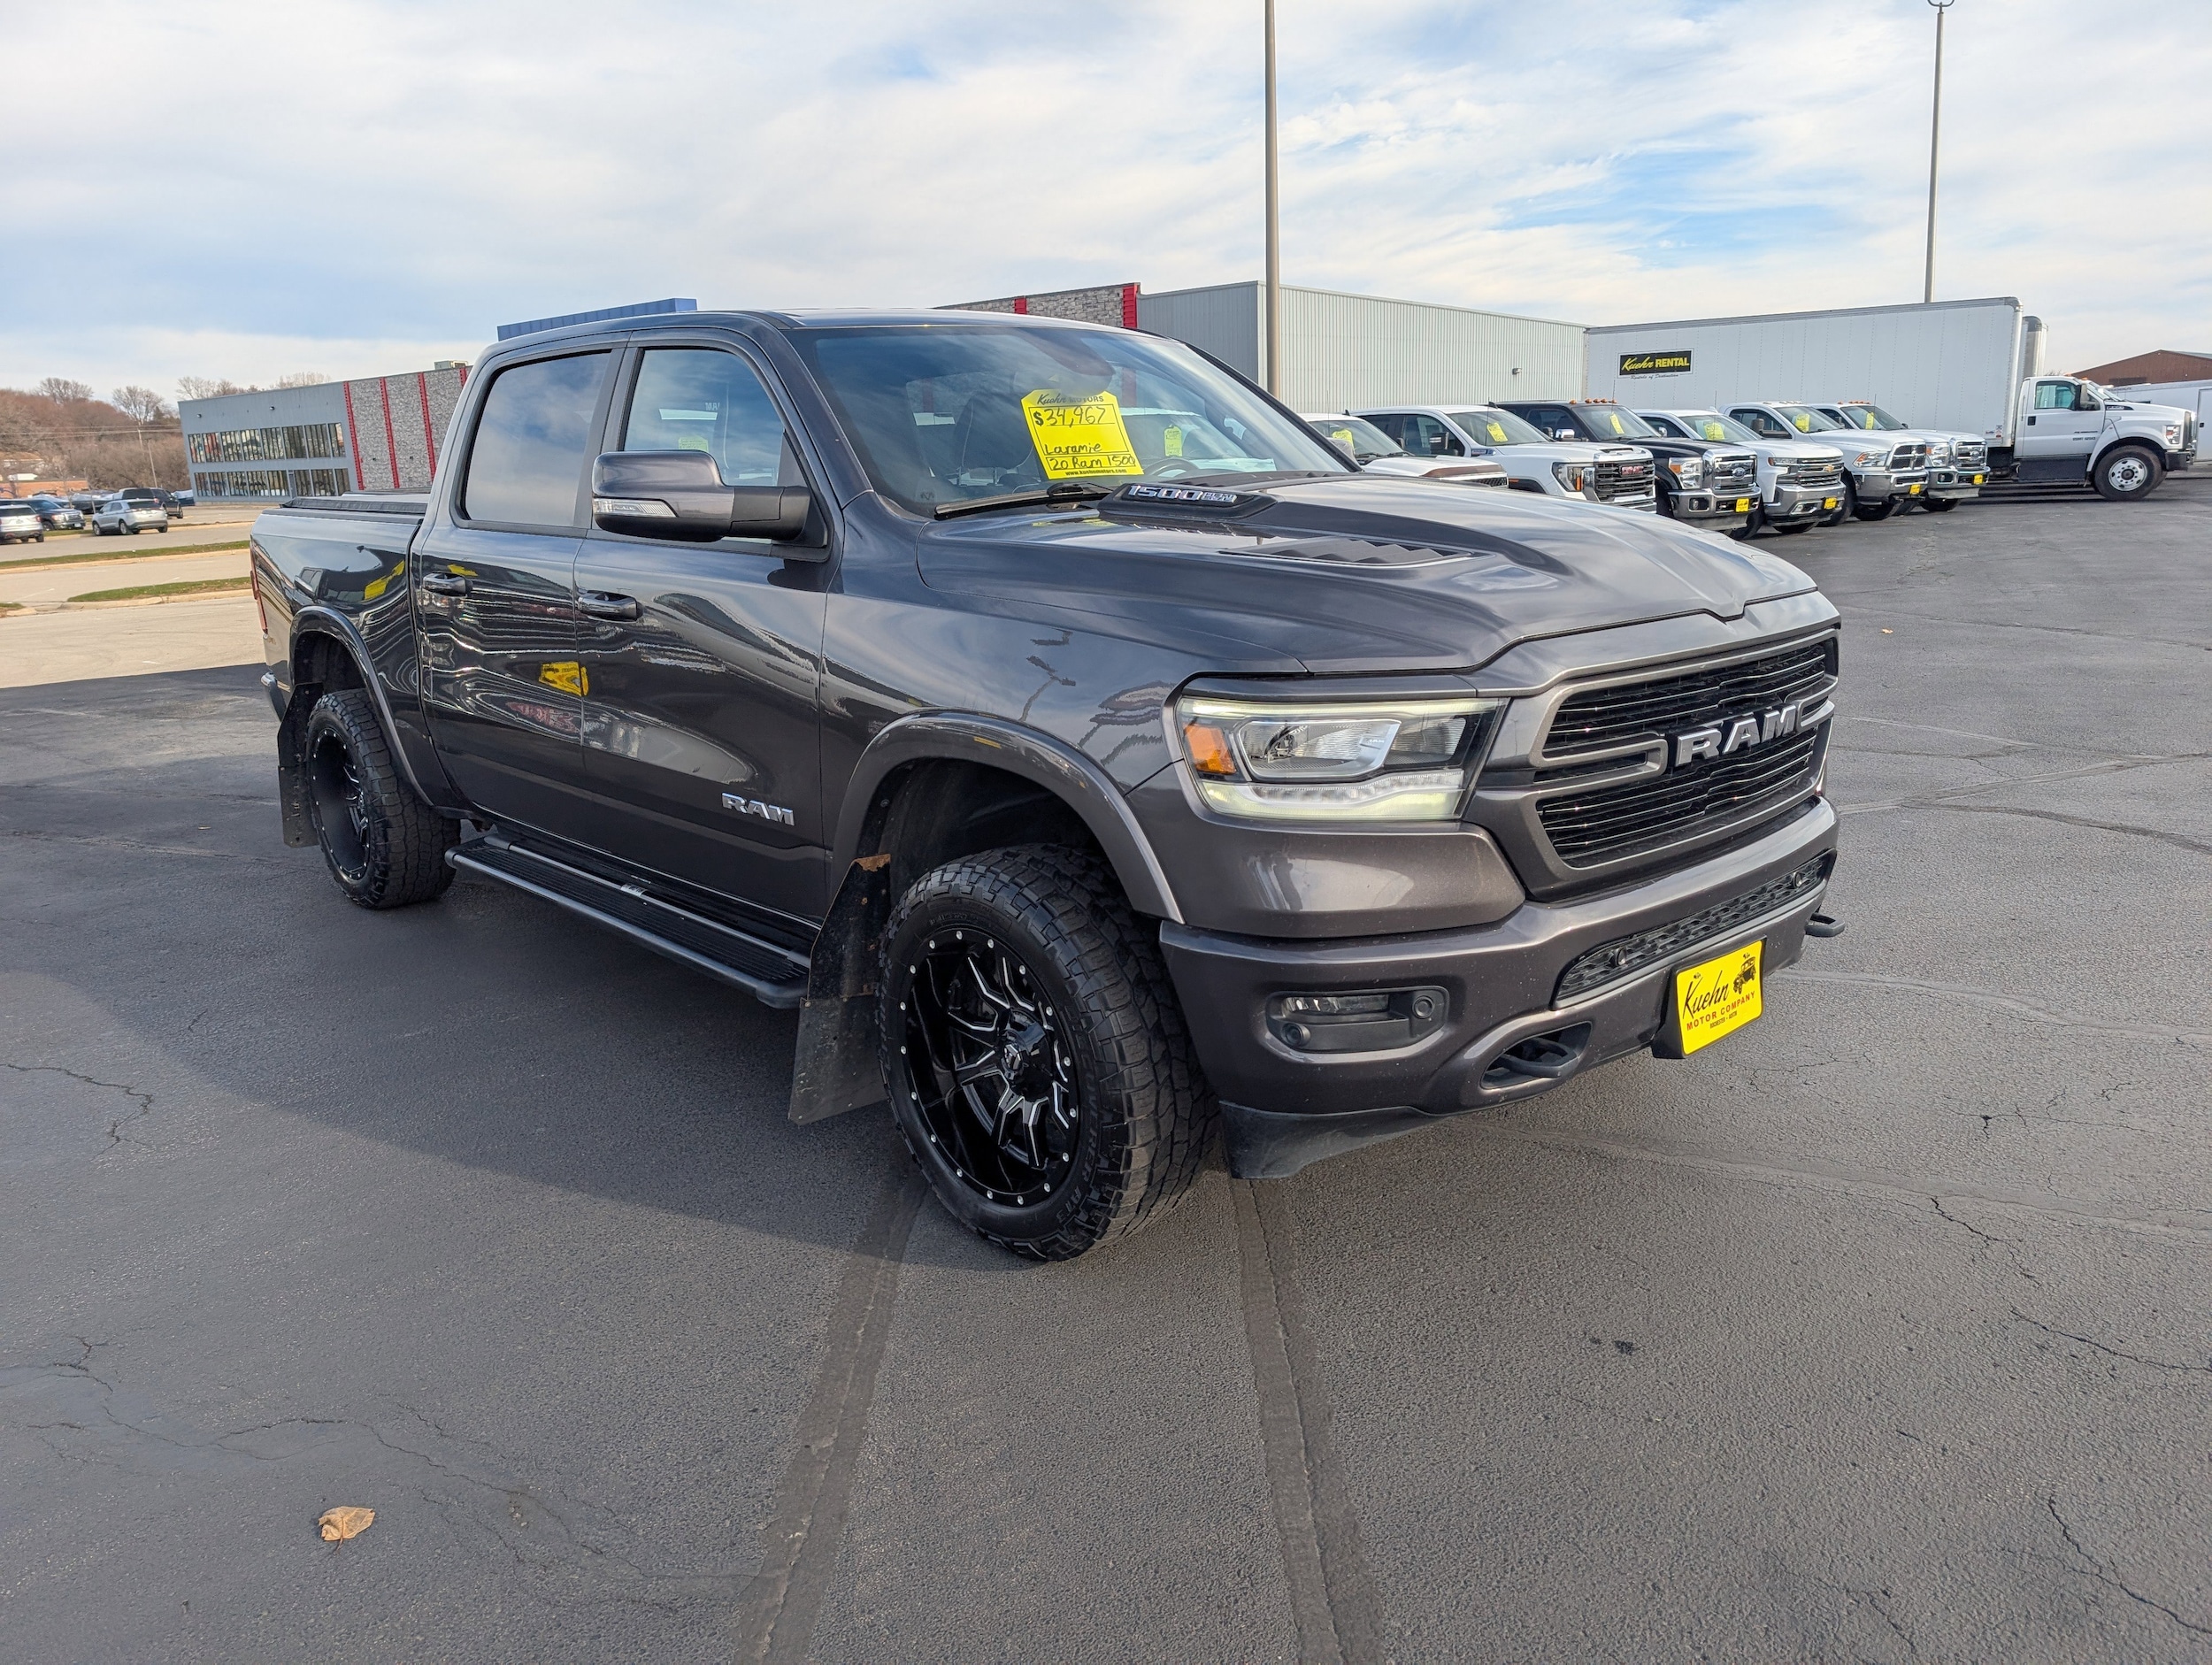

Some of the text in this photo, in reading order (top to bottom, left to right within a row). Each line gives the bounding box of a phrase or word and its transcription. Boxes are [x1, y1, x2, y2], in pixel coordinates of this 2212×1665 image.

[1621, 357, 1690, 371] Kuehn RENTAL
[1037, 392, 1067, 405] Kuehn
[1033, 406, 1106, 427] $34,967
[1044, 442, 1102, 455] Laramie
[1049, 455, 1136, 470] 20 Ram 1500
[1128, 485, 1203, 501] 1500
[1675, 705, 1797, 767] RAM
[721, 792, 795, 826] RAM
[1683, 970, 1730, 1019] Kuehn
[1686, 991, 1755, 1031] MOTOR COMPANY
